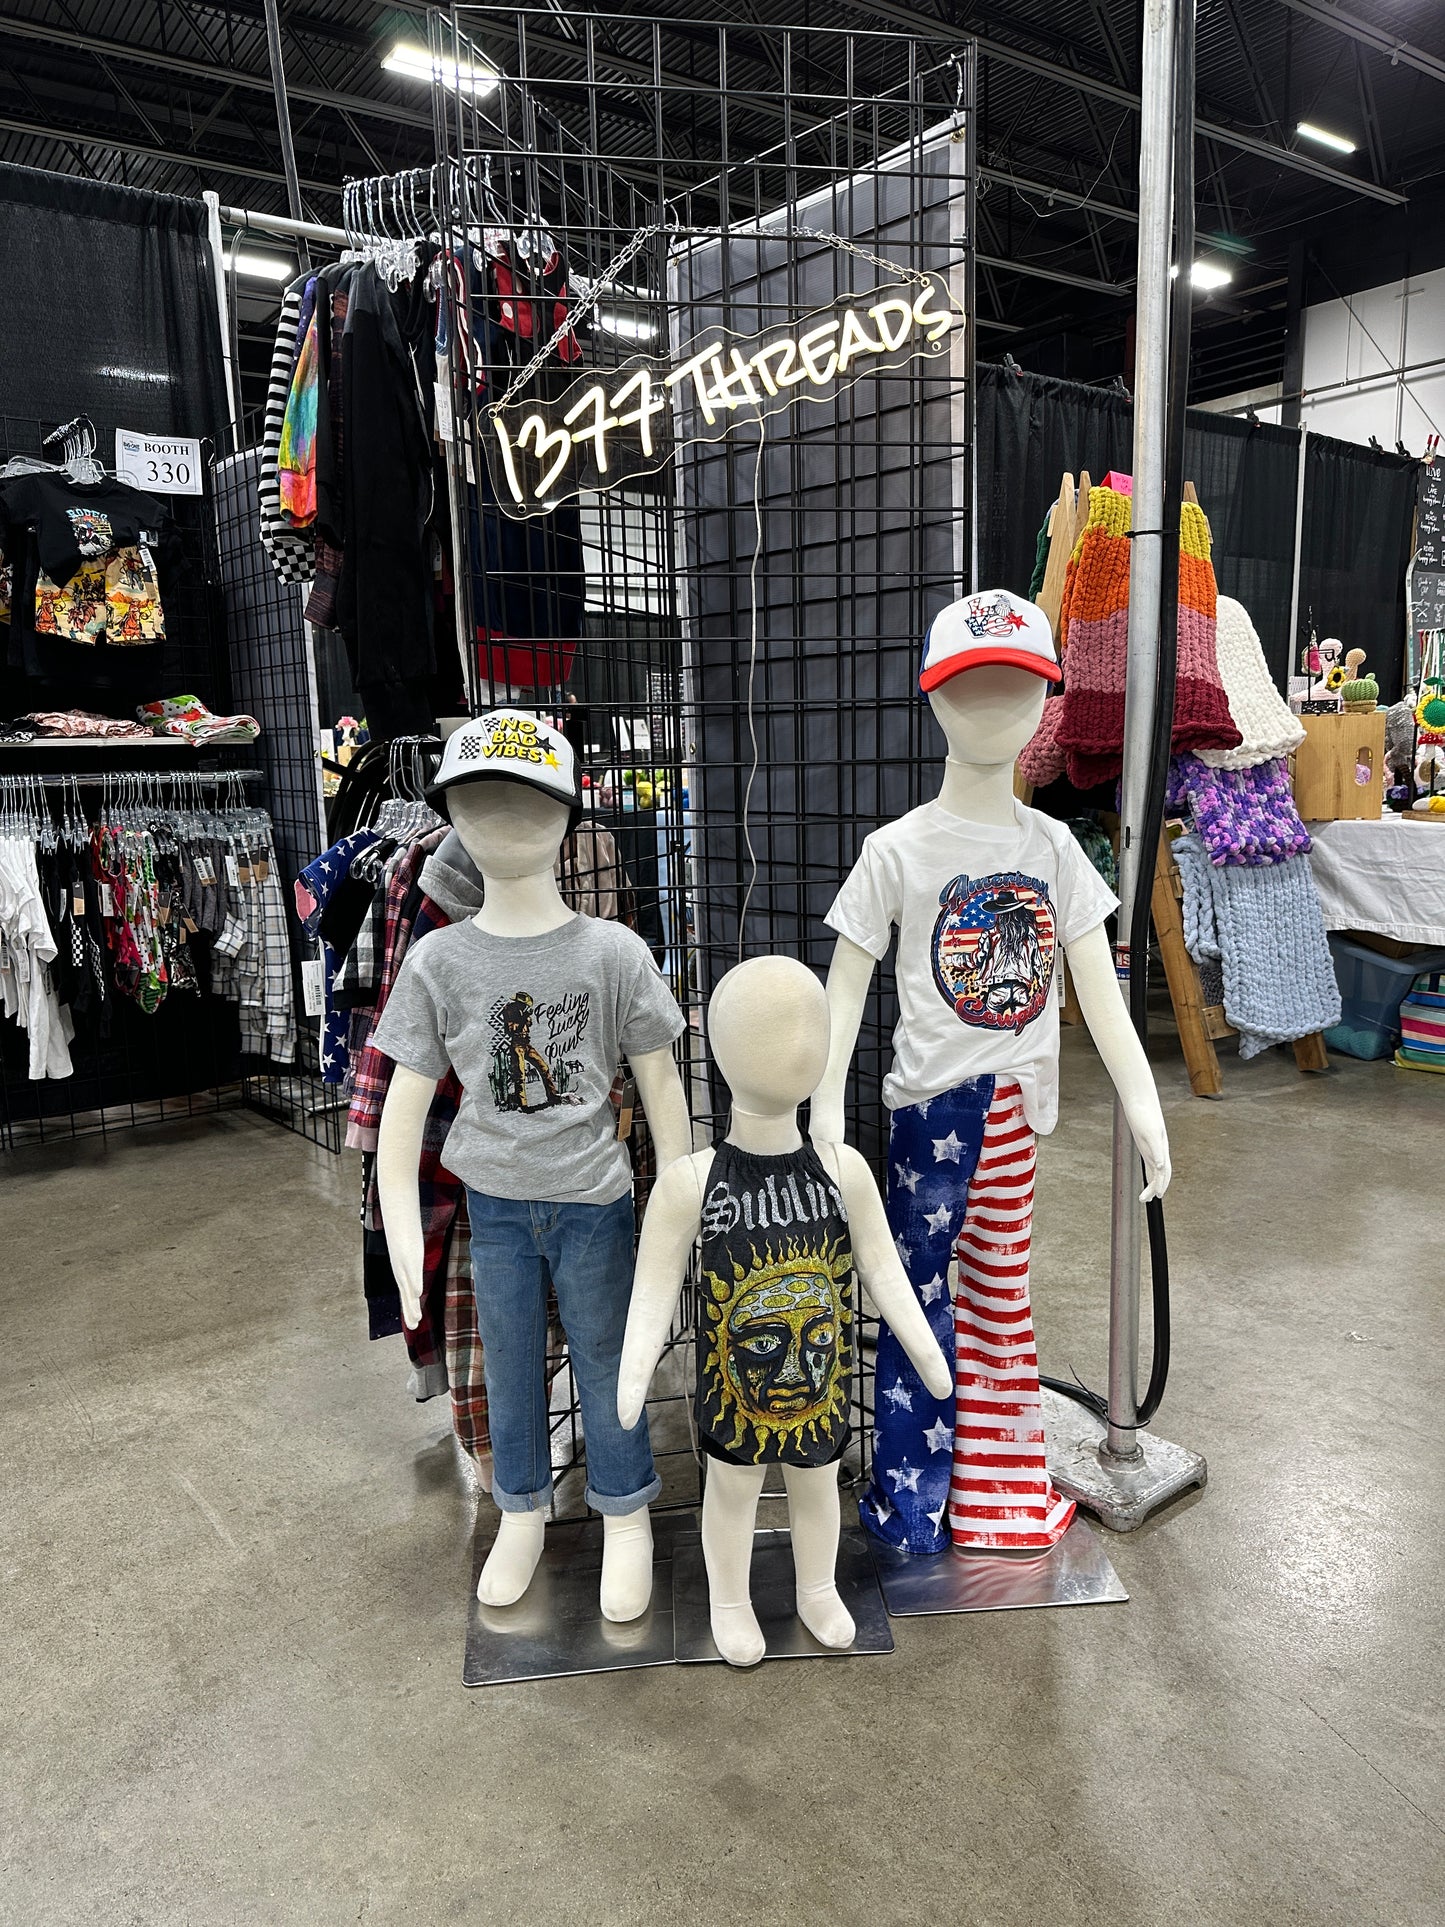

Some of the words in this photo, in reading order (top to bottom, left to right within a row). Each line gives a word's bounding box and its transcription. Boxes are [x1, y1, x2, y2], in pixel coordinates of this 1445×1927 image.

[492, 370, 665, 503] 1377
[664, 286, 953, 425] THREADS
[144, 442, 189, 456] BOOTH
[146, 460, 190, 485] 330
[492, 731, 538, 748] BAD
[500, 717, 537, 734] NO
[482, 745, 542, 763] VIBES
[938, 871, 1050, 912] American
[533, 992, 590, 1024] Feeling
[547, 1007, 590, 1040] Lucky
[544, 1024, 585, 1065] Punk
